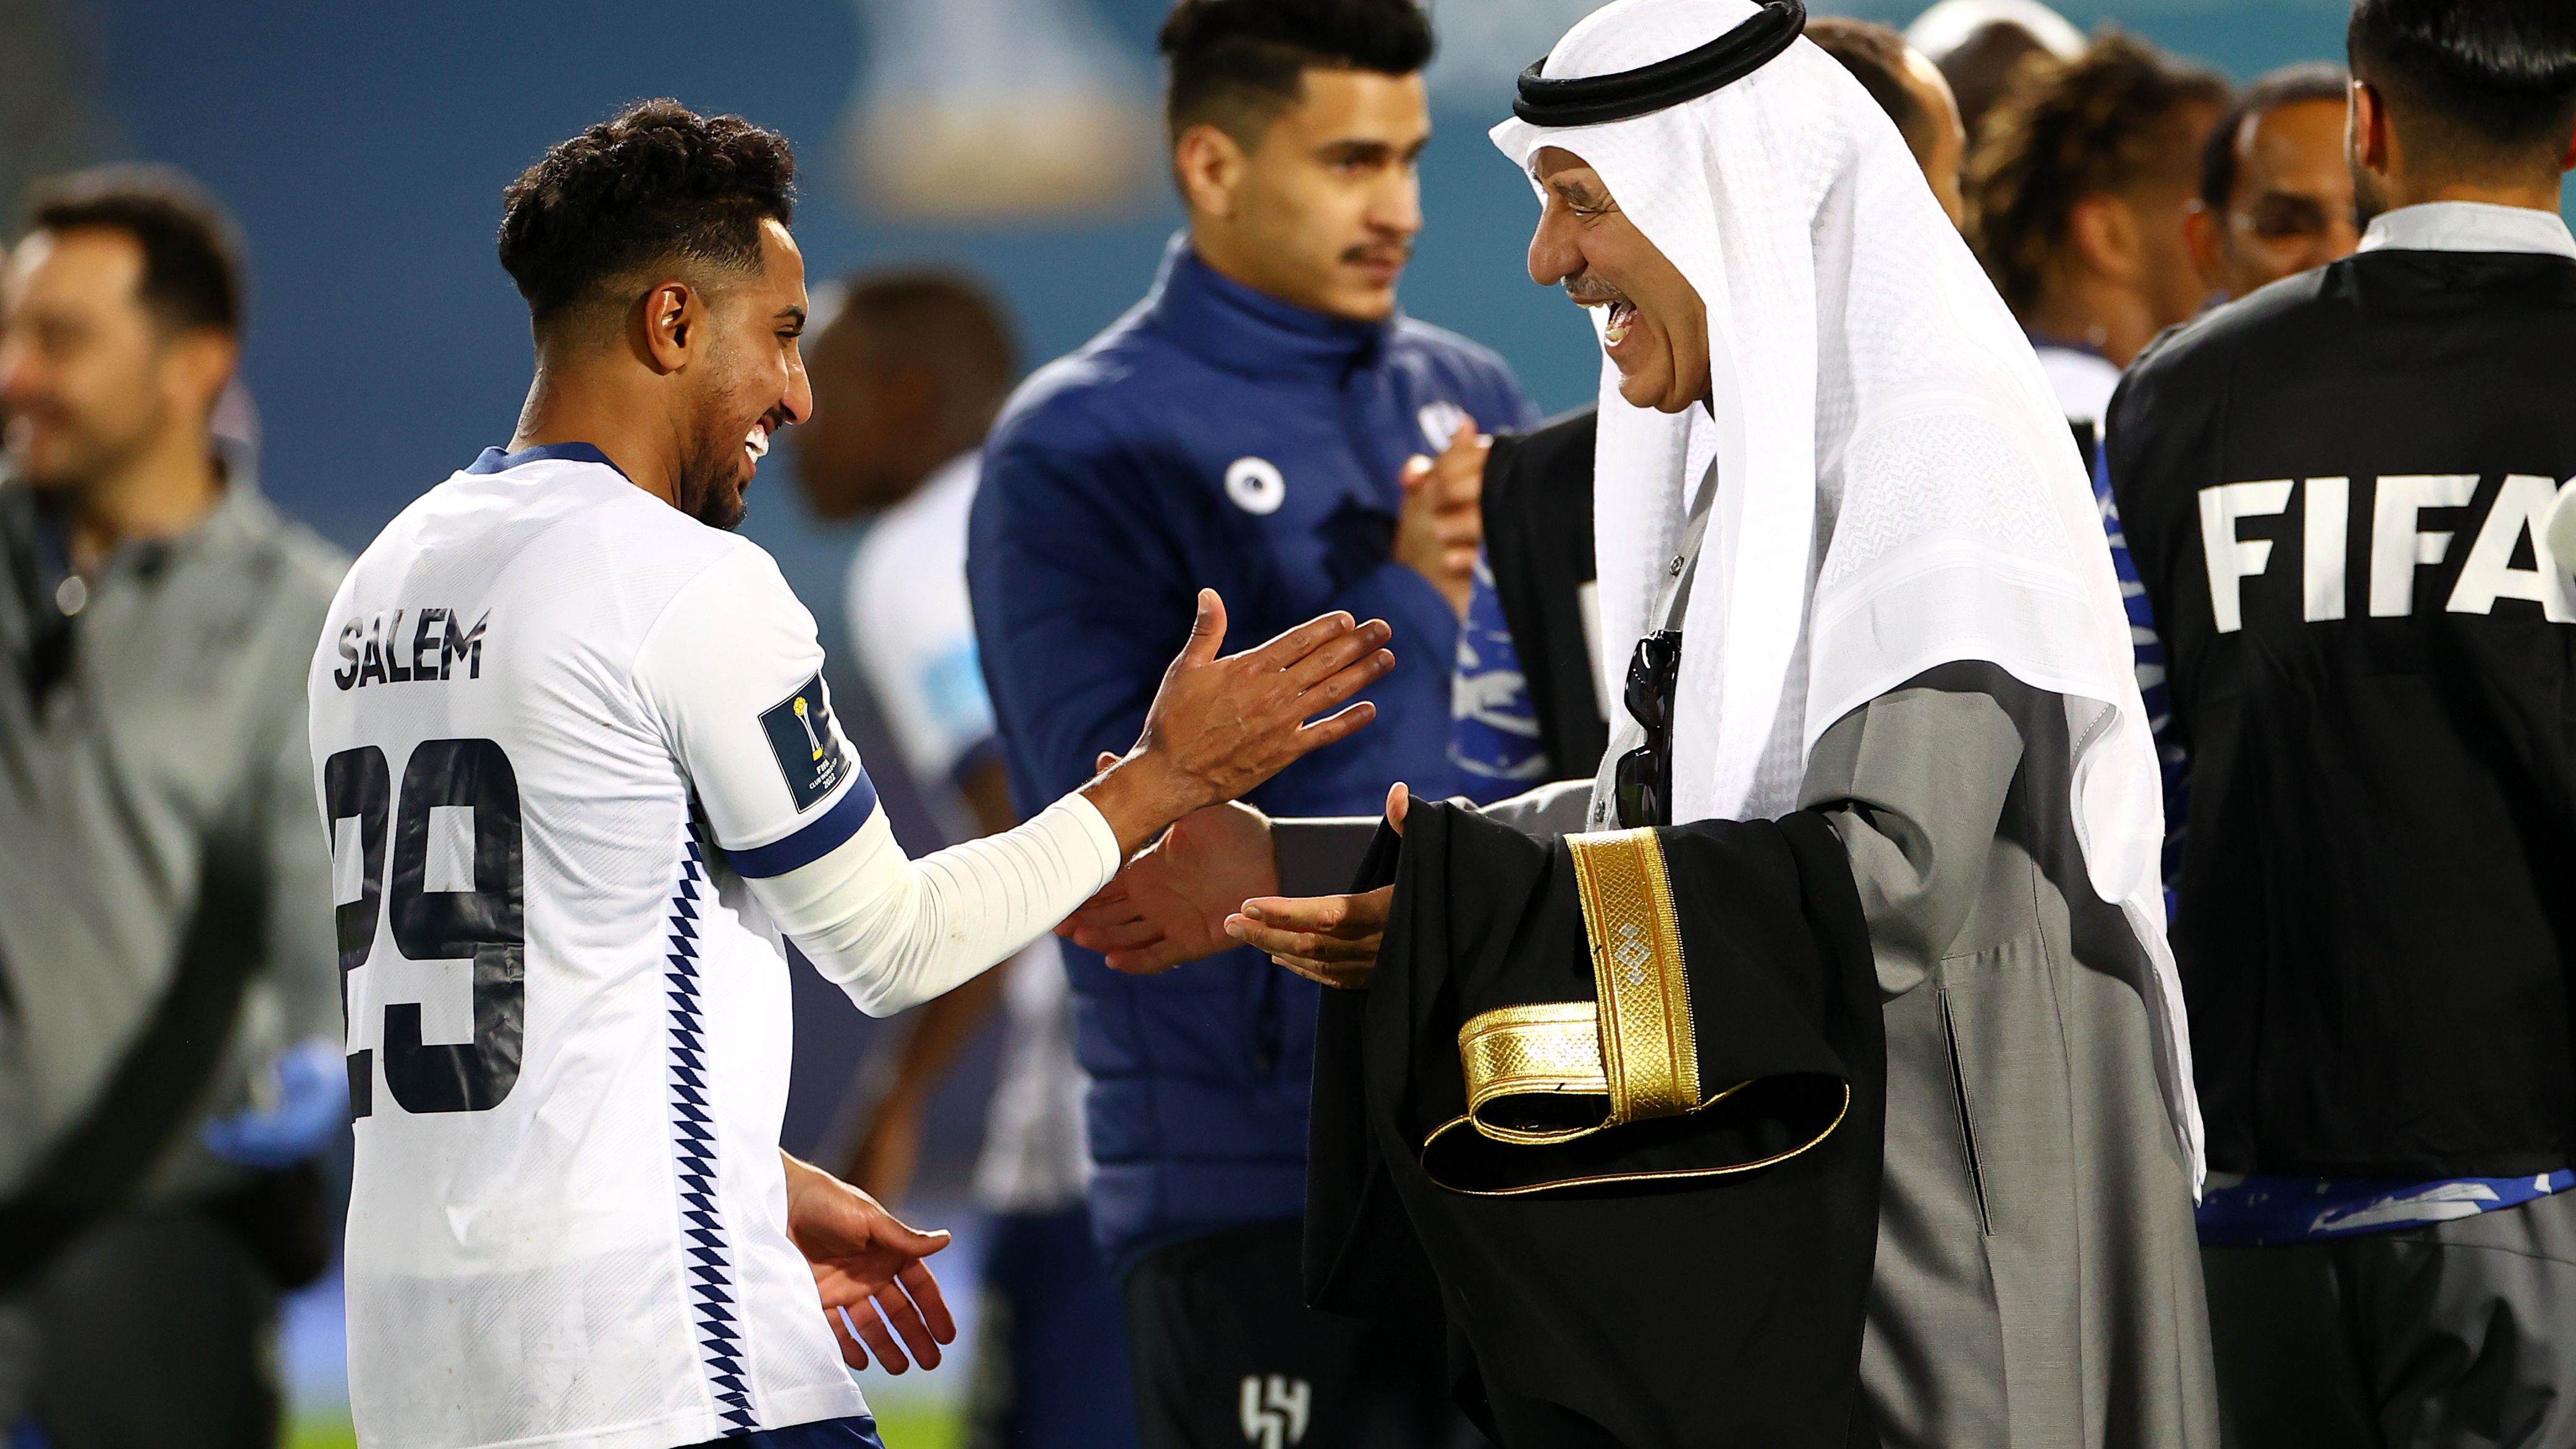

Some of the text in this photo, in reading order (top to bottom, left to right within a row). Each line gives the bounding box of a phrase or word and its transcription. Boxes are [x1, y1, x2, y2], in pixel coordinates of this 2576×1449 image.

[2198, 473, 2576, 633] FIFA
[334, 607, 492, 691] SALEM
[809, 777, 822, 789] CLUB
[816, 759, 830, 775] FIFA
[822, 772, 836, 789] 2022
[324, 738, 525, 1123] 29
